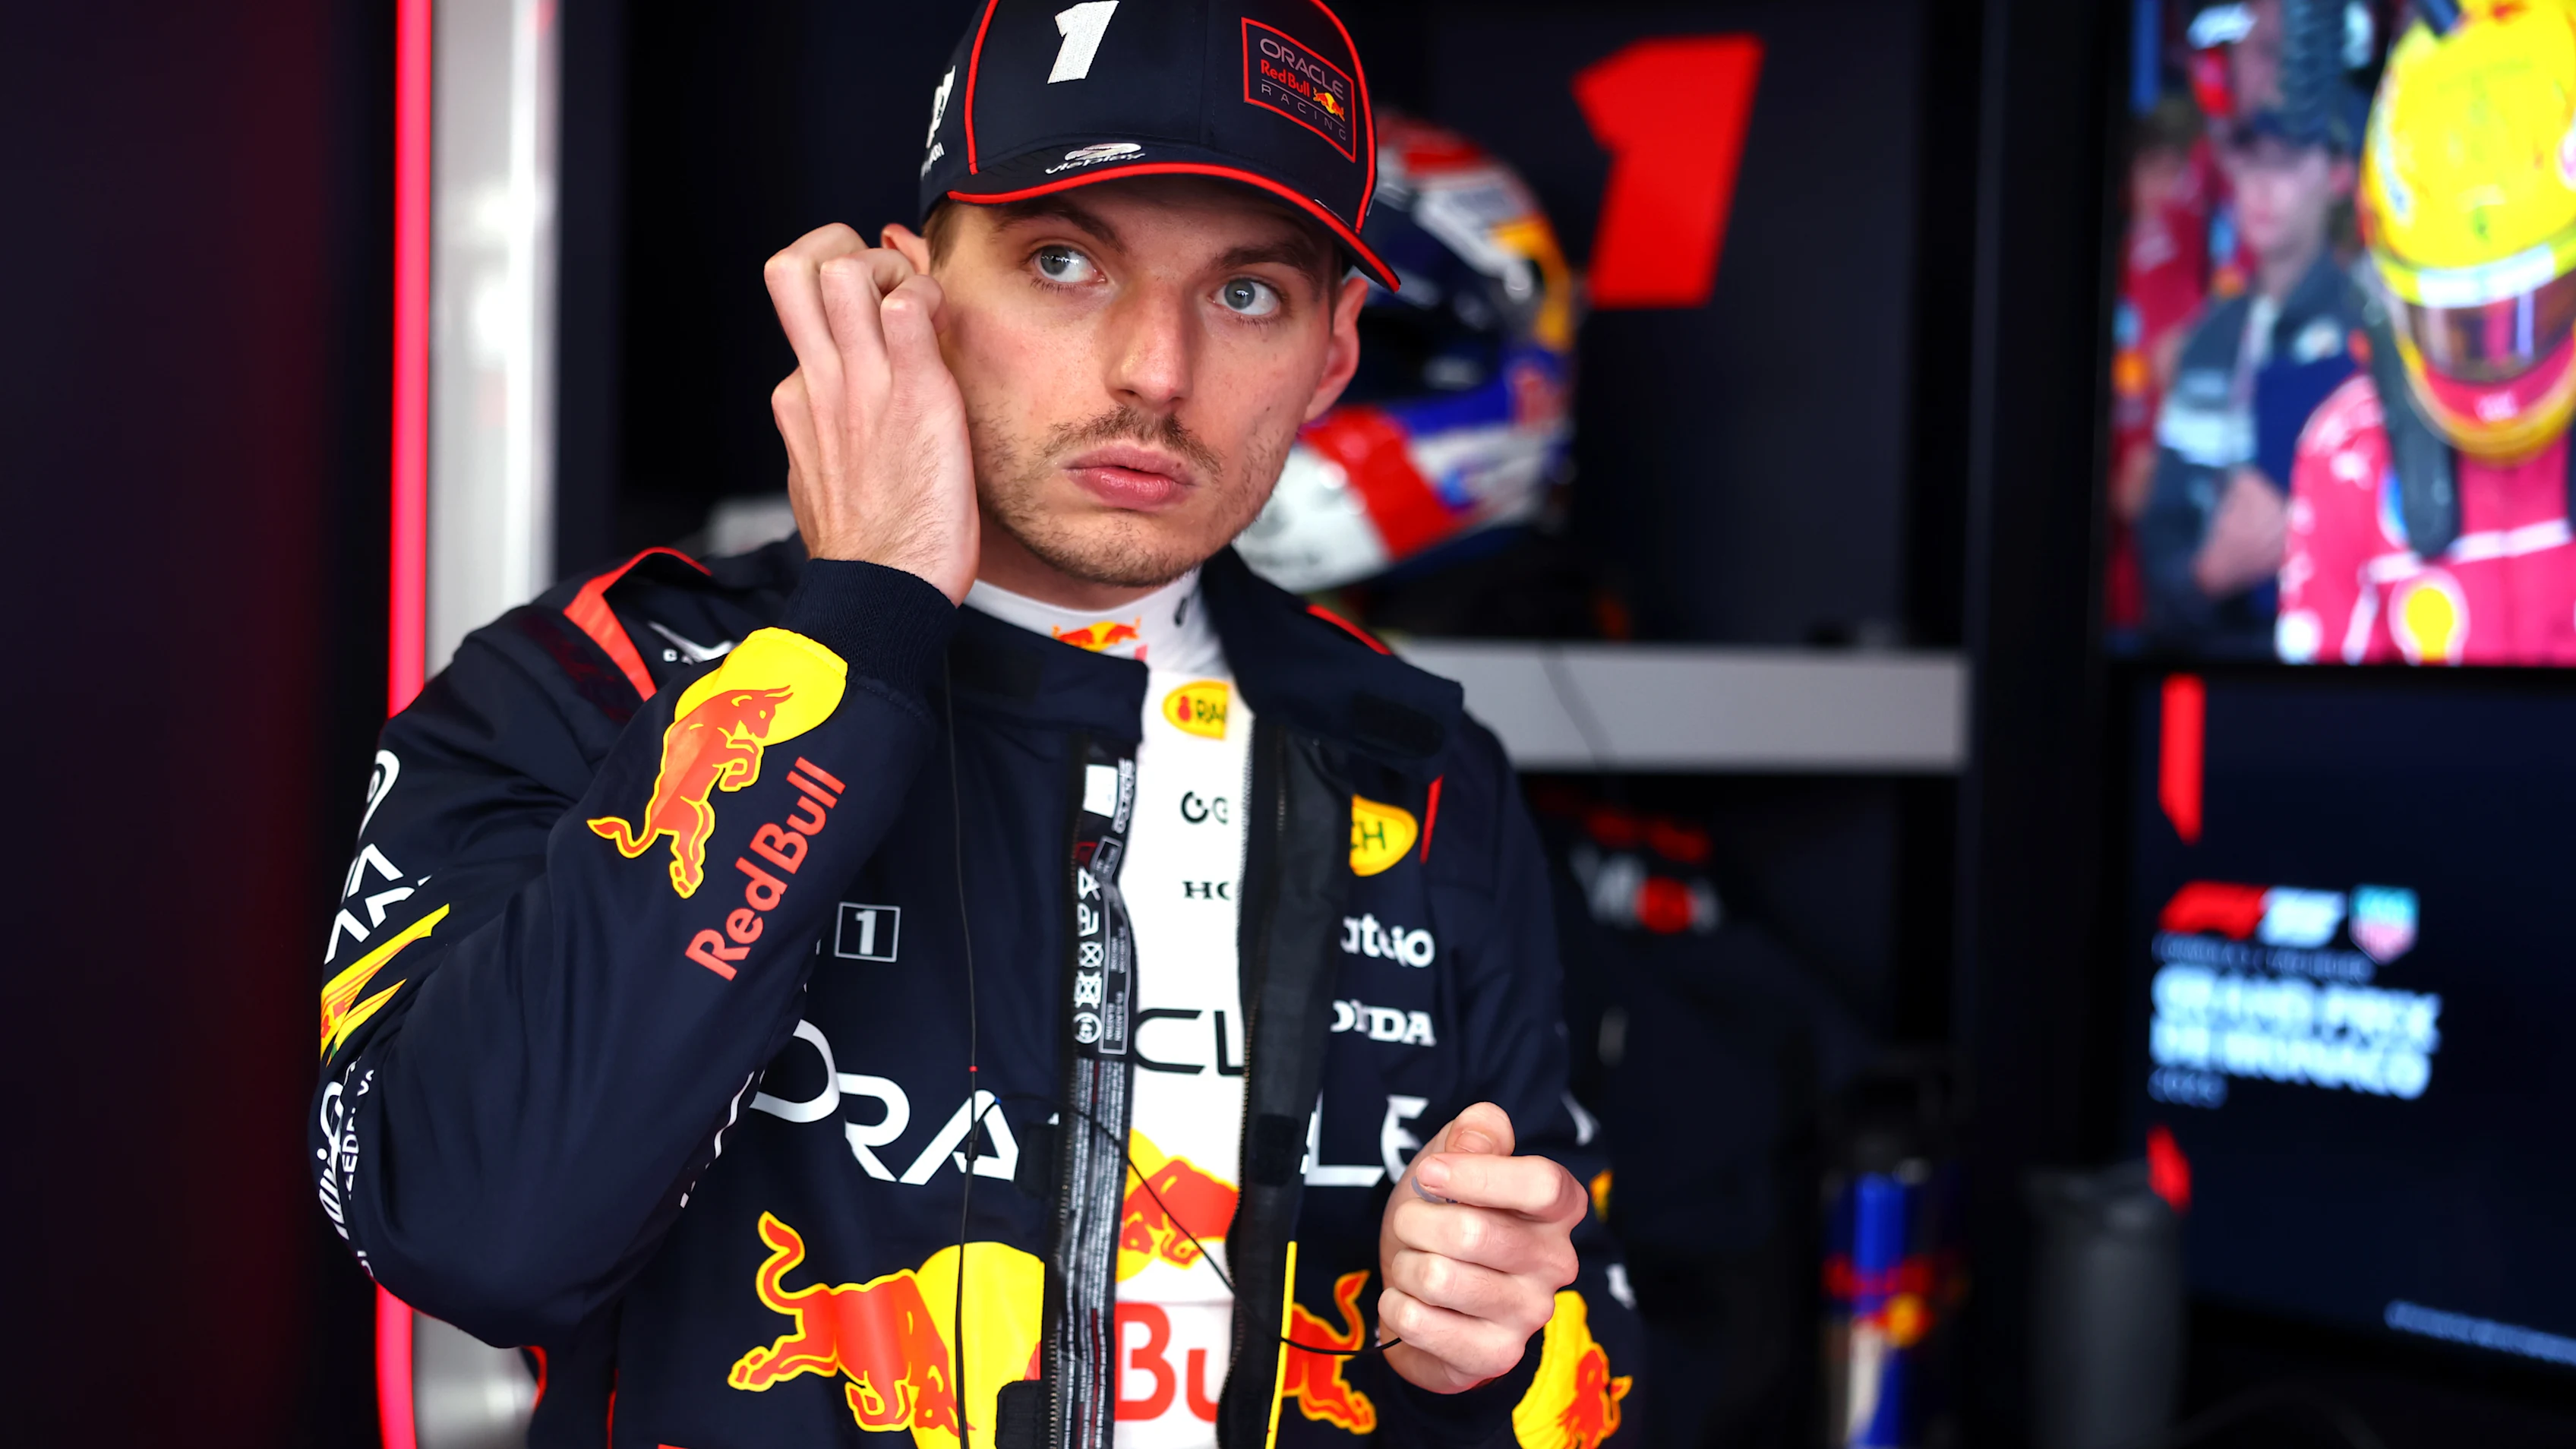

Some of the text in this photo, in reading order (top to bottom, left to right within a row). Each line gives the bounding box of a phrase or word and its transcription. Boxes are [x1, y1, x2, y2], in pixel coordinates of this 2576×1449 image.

[1047, 0, 1119, 84] 1
[1260, 38, 1344, 100] ORACLE
[1261, 84, 1346, 140] RACING
[1569, 33, 1764, 308] 1
